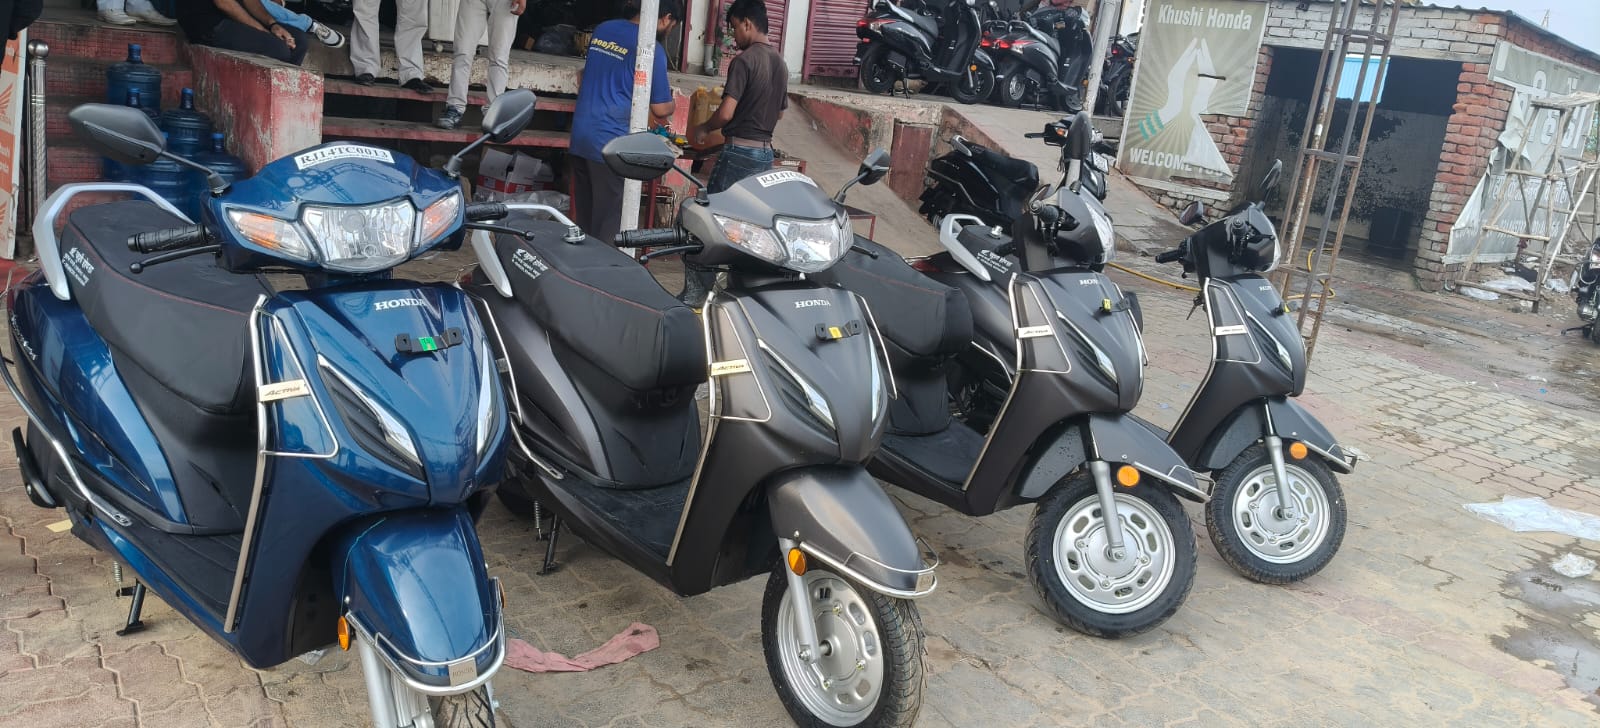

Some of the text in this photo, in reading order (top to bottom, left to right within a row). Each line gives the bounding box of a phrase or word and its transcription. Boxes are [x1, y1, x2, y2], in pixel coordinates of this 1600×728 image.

[1158, 4, 1252, 30] Khushi Honda
[374, 298, 427, 311] HONDA
[795, 300, 831, 309] HONDA
